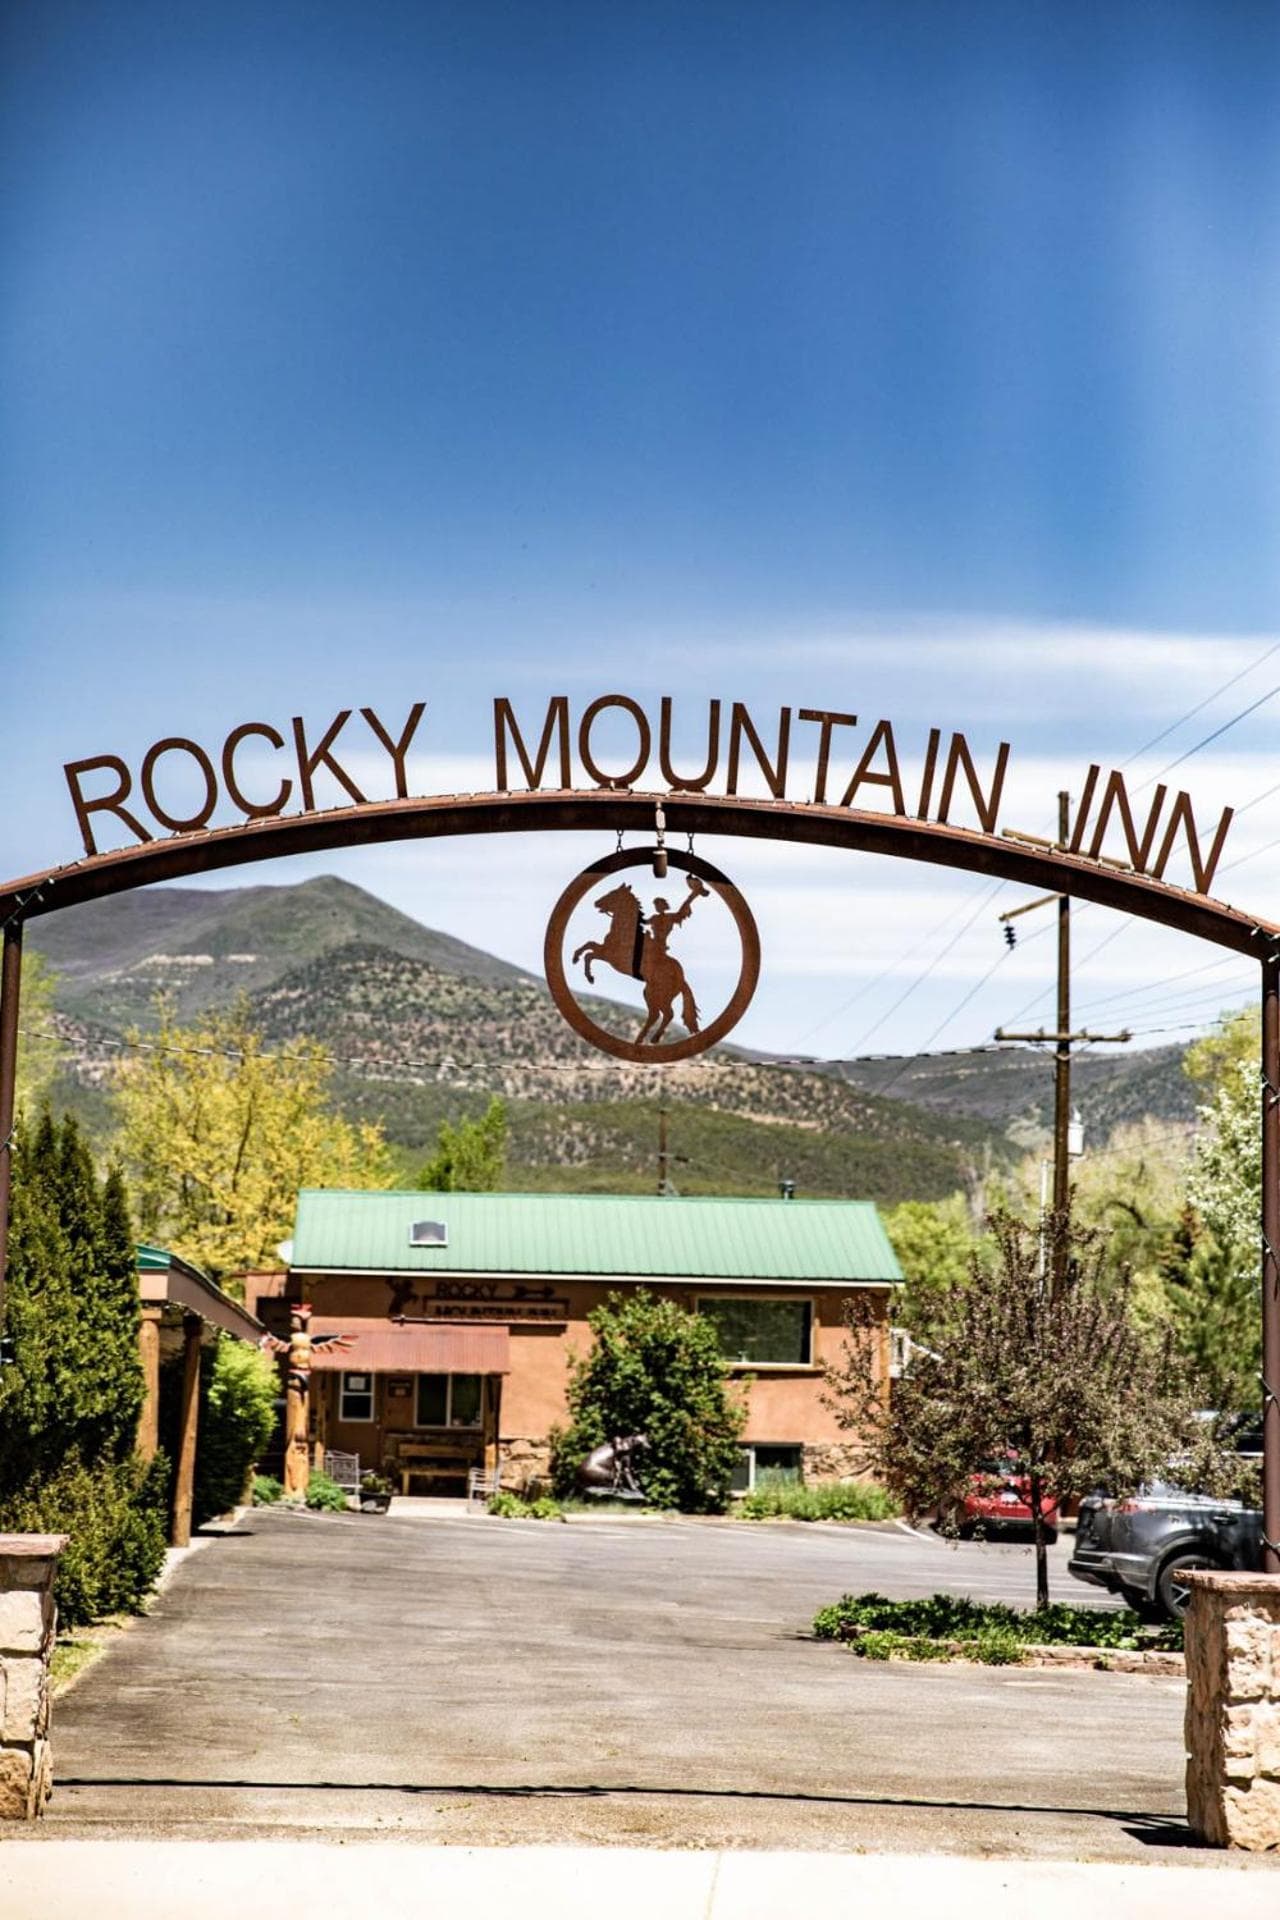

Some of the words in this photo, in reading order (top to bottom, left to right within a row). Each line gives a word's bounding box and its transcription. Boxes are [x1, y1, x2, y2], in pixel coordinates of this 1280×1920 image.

[63, 702, 427, 857] ROCKY
[494, 694, 1010, 835] MOUNTAIN
[1069, 764, 1235, 895] INN
[435, 1282, 498, 1297] ROCKY
